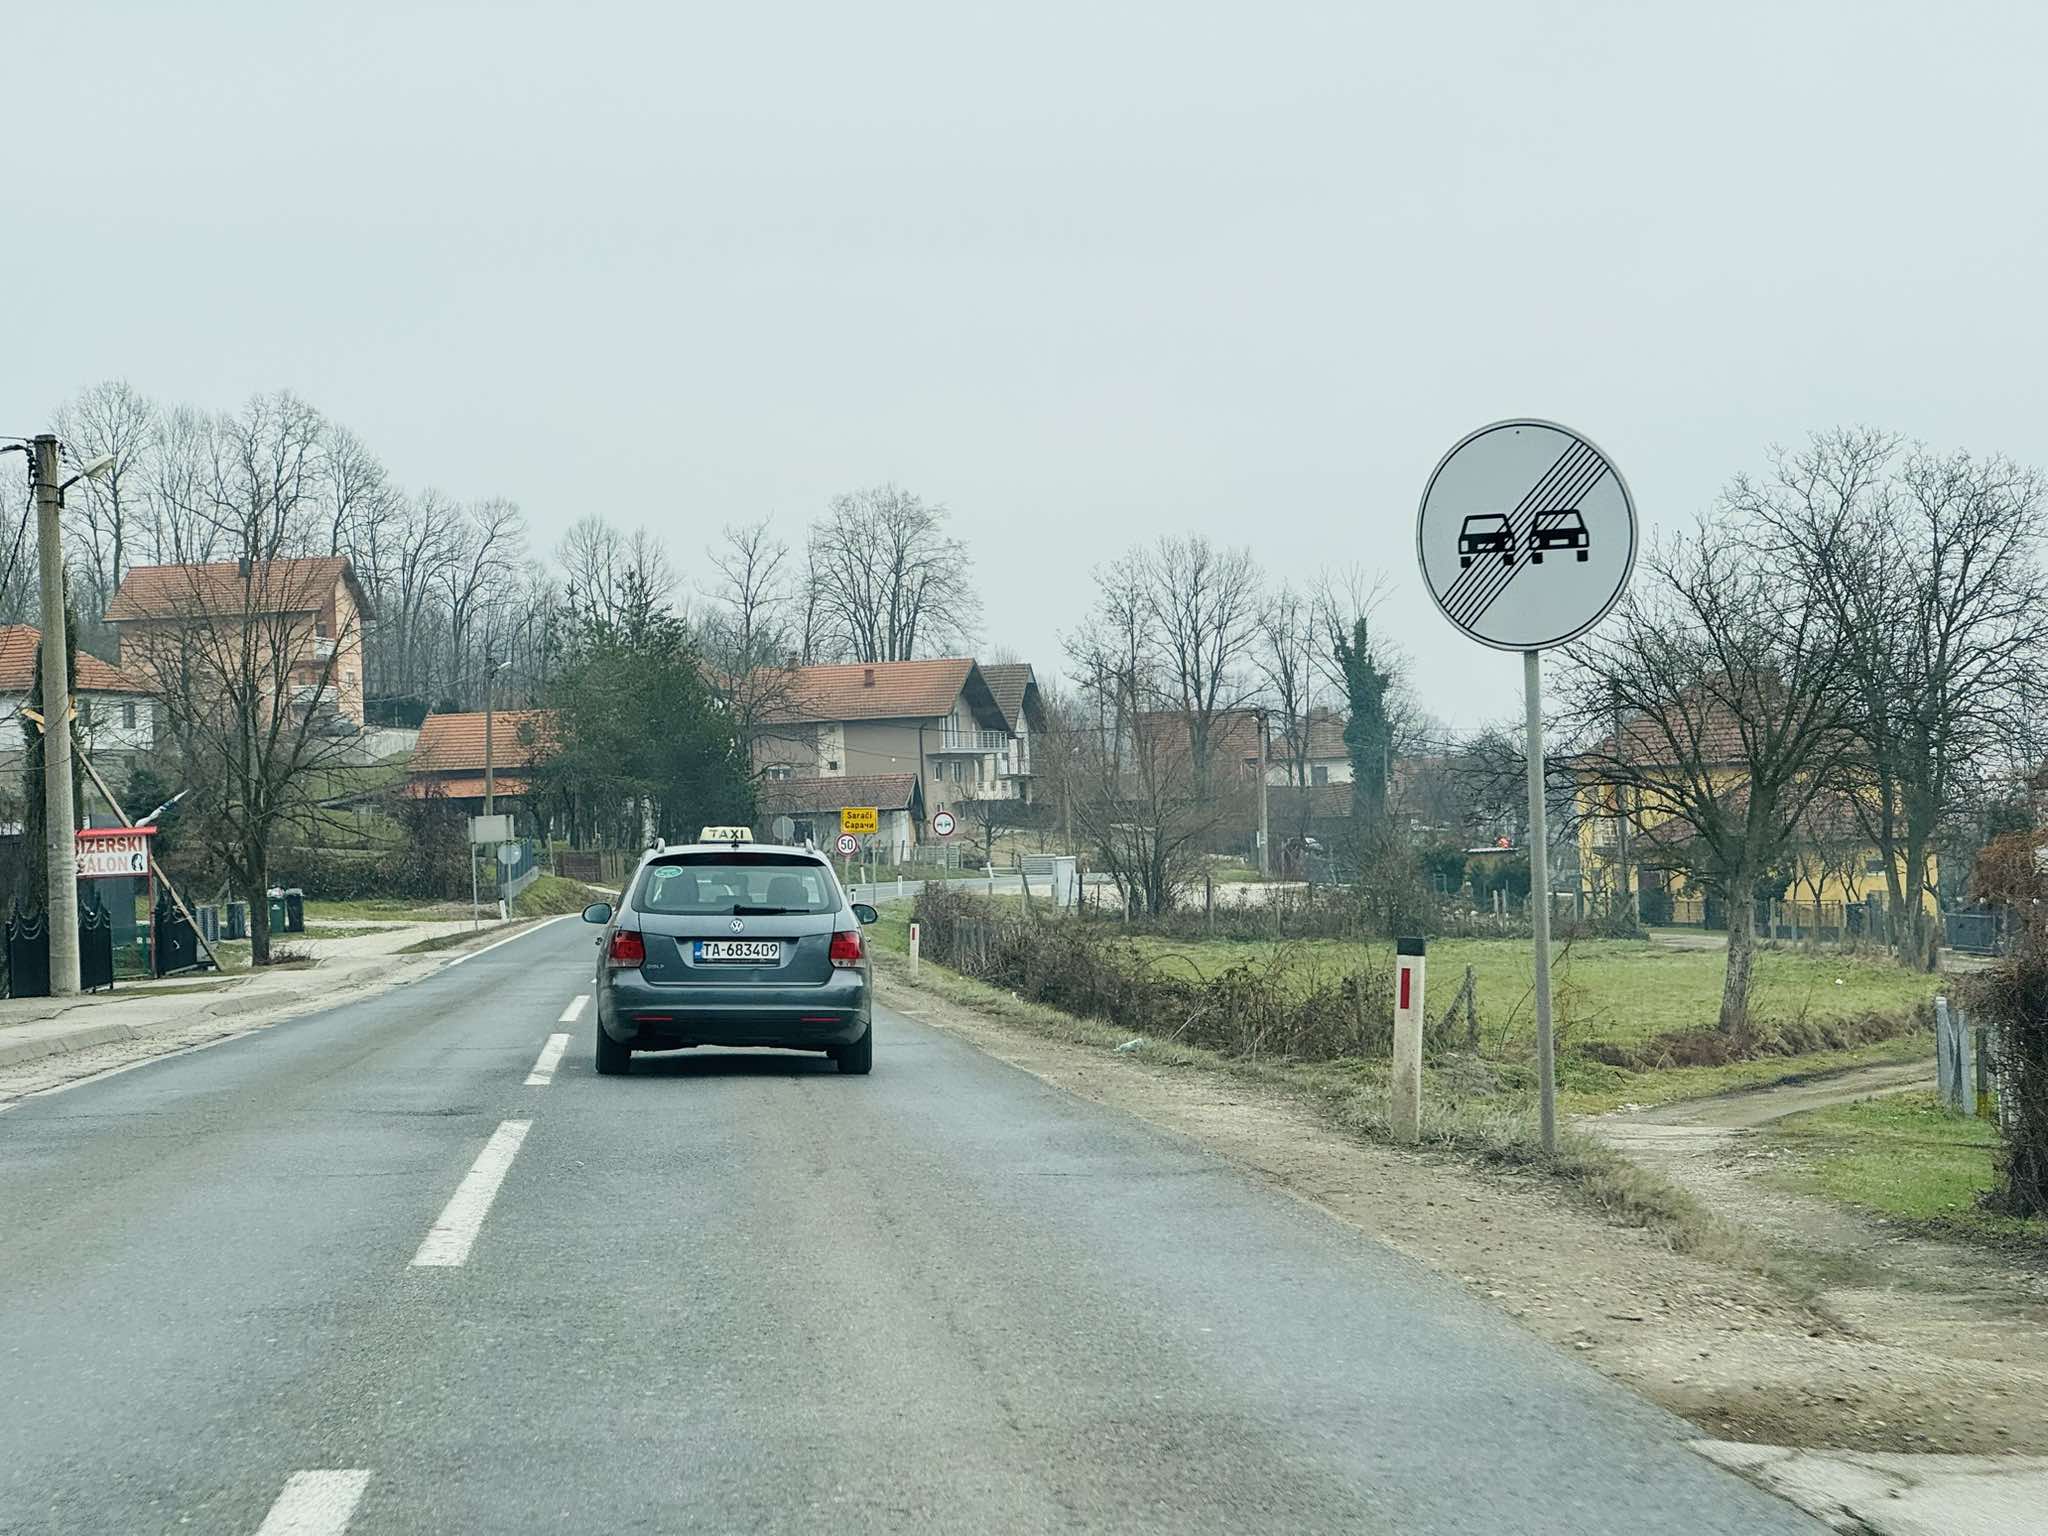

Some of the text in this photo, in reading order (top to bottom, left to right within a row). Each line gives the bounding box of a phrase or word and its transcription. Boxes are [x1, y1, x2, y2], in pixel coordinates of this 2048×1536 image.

[709, 829, 744, 839] TAXI
[840, 838, 853, 850] 50
[704, 943, 778, 957] TA-683409
